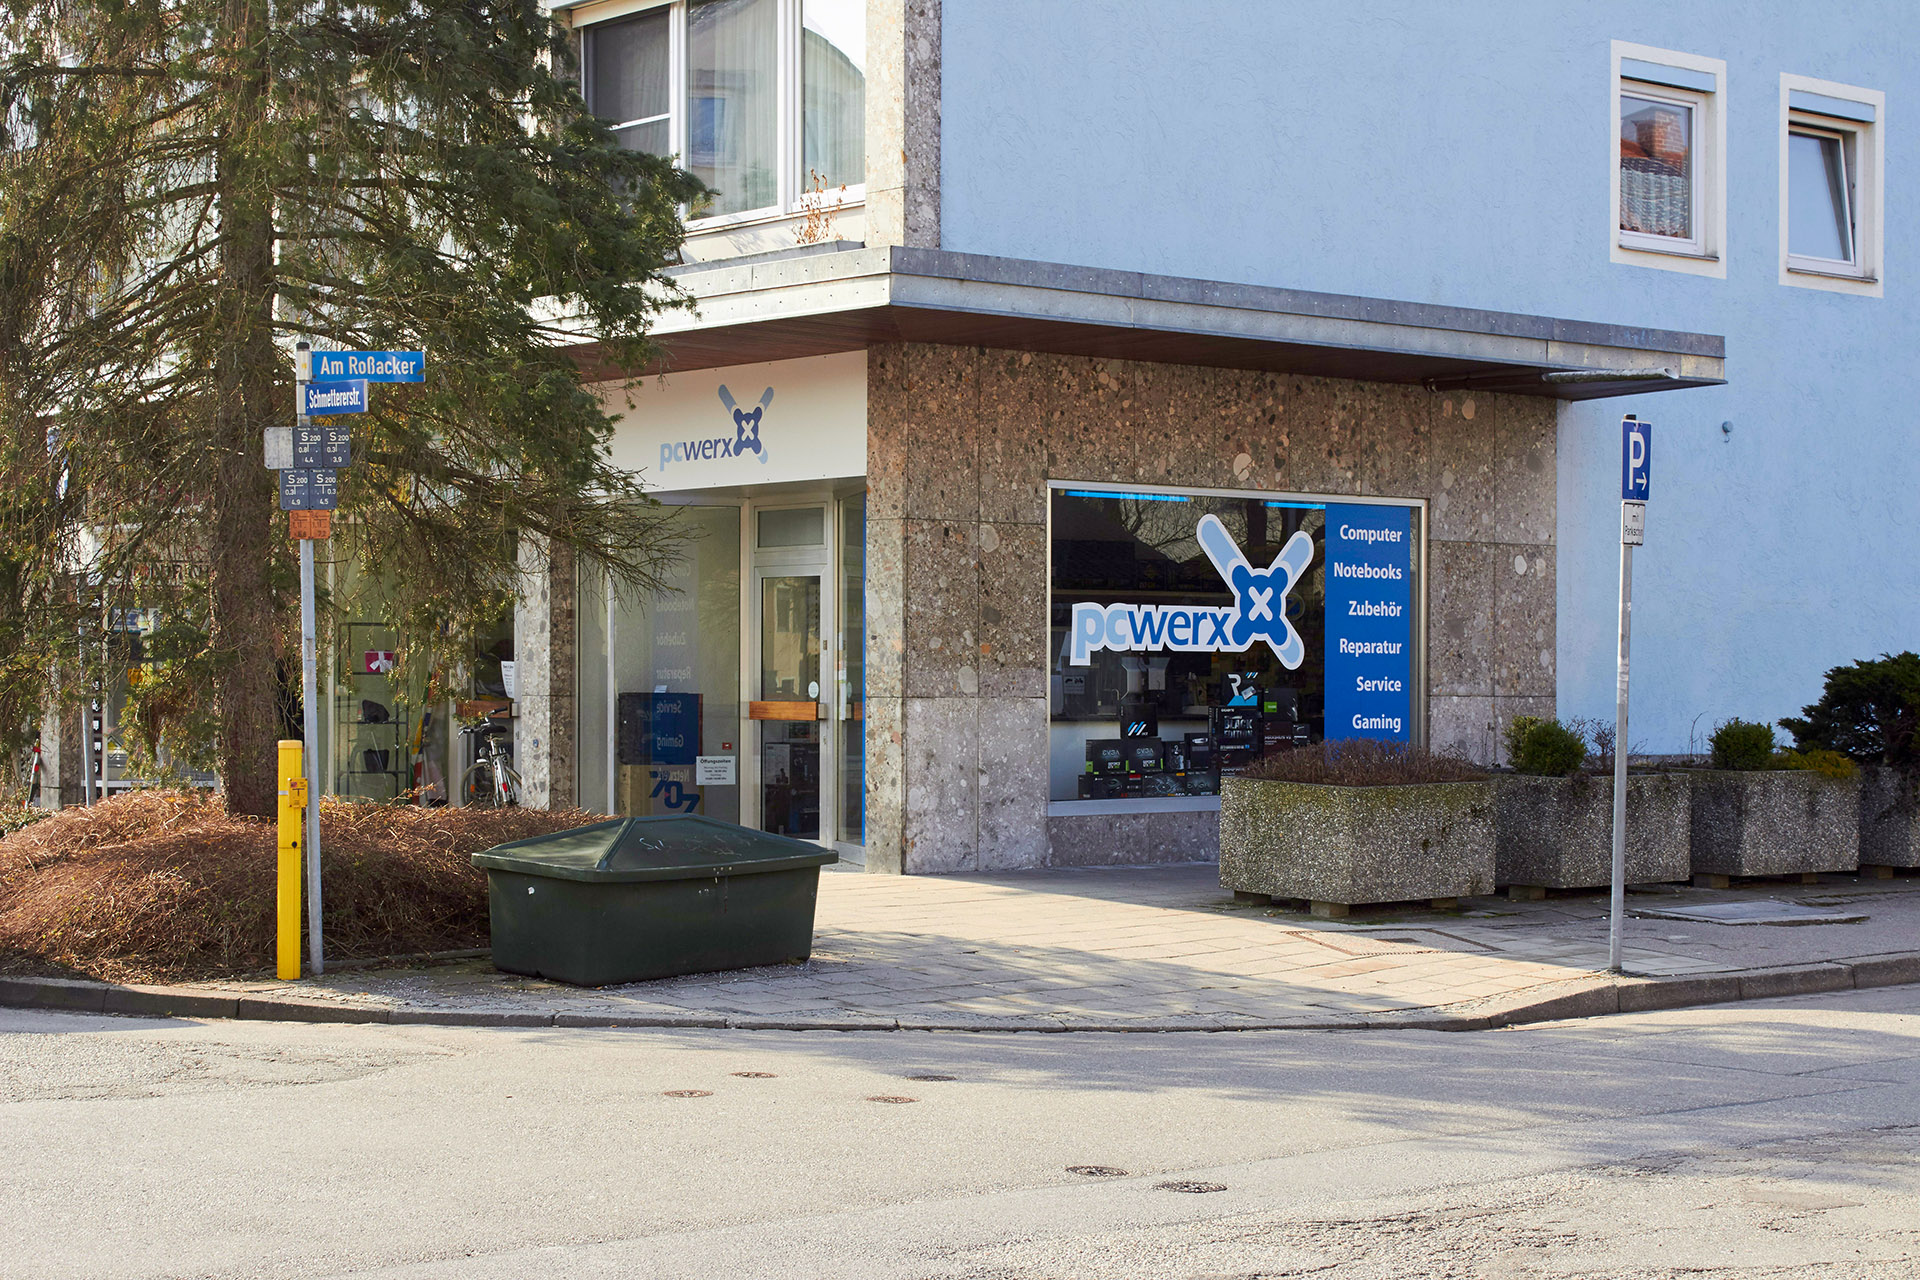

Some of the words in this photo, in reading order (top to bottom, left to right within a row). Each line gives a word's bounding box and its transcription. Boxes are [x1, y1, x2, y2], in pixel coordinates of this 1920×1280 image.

[320, 356, 344, 375] Am
[348, 356, 416, 375] Roßacker
[308, 386, 361, 409] Schmettererstr.
[301, 432, 309, 441] S
[329, 432, 337, 441] S
[659, 434, 734, 471] pcwerx
[1628, 431, 1645, 490] P
[287, 474, 295, 484] S
[316, 474, 324, 483] S
[1339, 525, 1402, 544] Computer
[1333, 562, 1402, 580] Notebooks
[1348, 600, 1402, 617] Zubehör
[1075, 608, 1231, 659] pcwerx
[1339, 638, 1402, 659] Reparatur
[1356, 676, 1402, 692] Service
[1224, 718, 1253, 730] BLACK
[1352, 714, 1402, 733] Gaming
